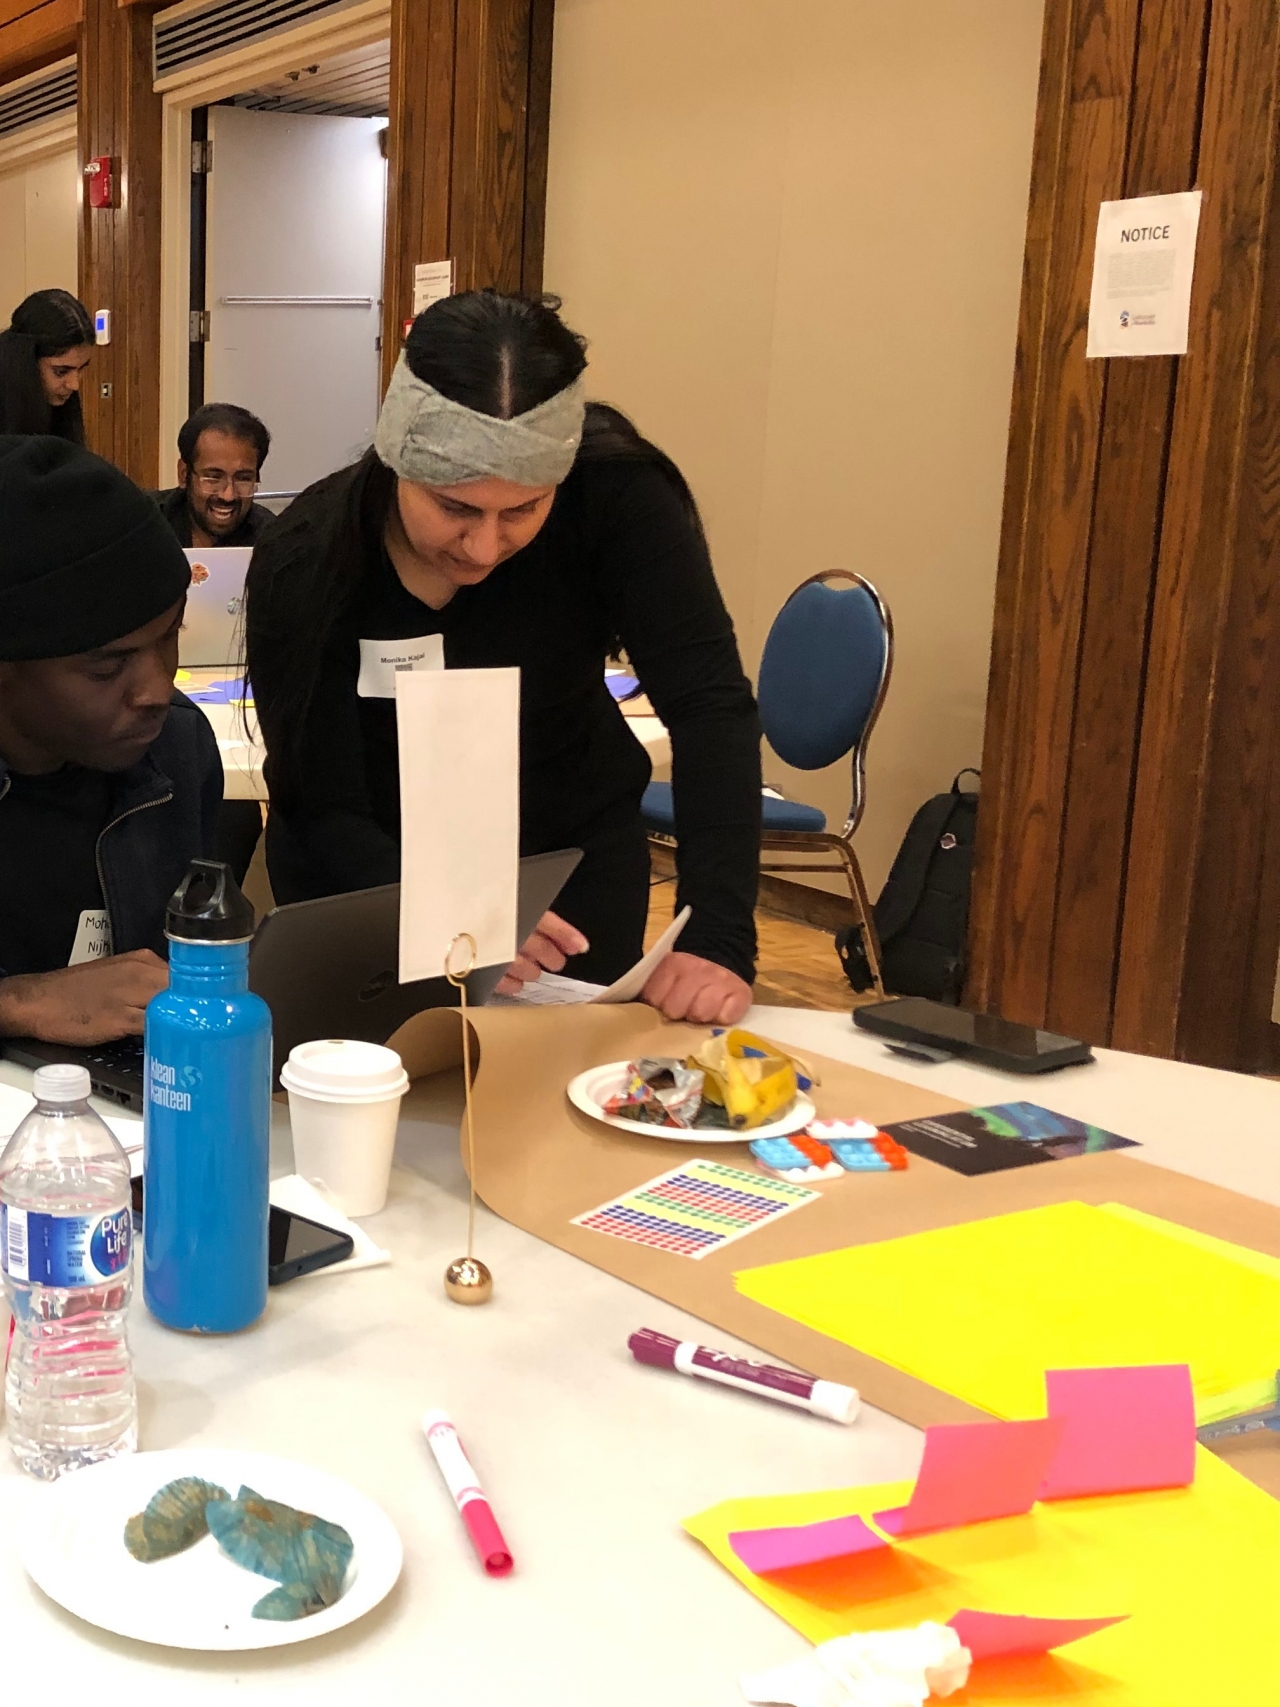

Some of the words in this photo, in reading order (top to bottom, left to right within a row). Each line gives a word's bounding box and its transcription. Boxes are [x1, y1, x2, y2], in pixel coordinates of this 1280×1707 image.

[1121, 225, 1170, 243] NOTICE
[151, 1079, 191, 1112] kanteen
[102, 1211, 128, 1237] Pure
[107, 1231, 127, 1254] Life
